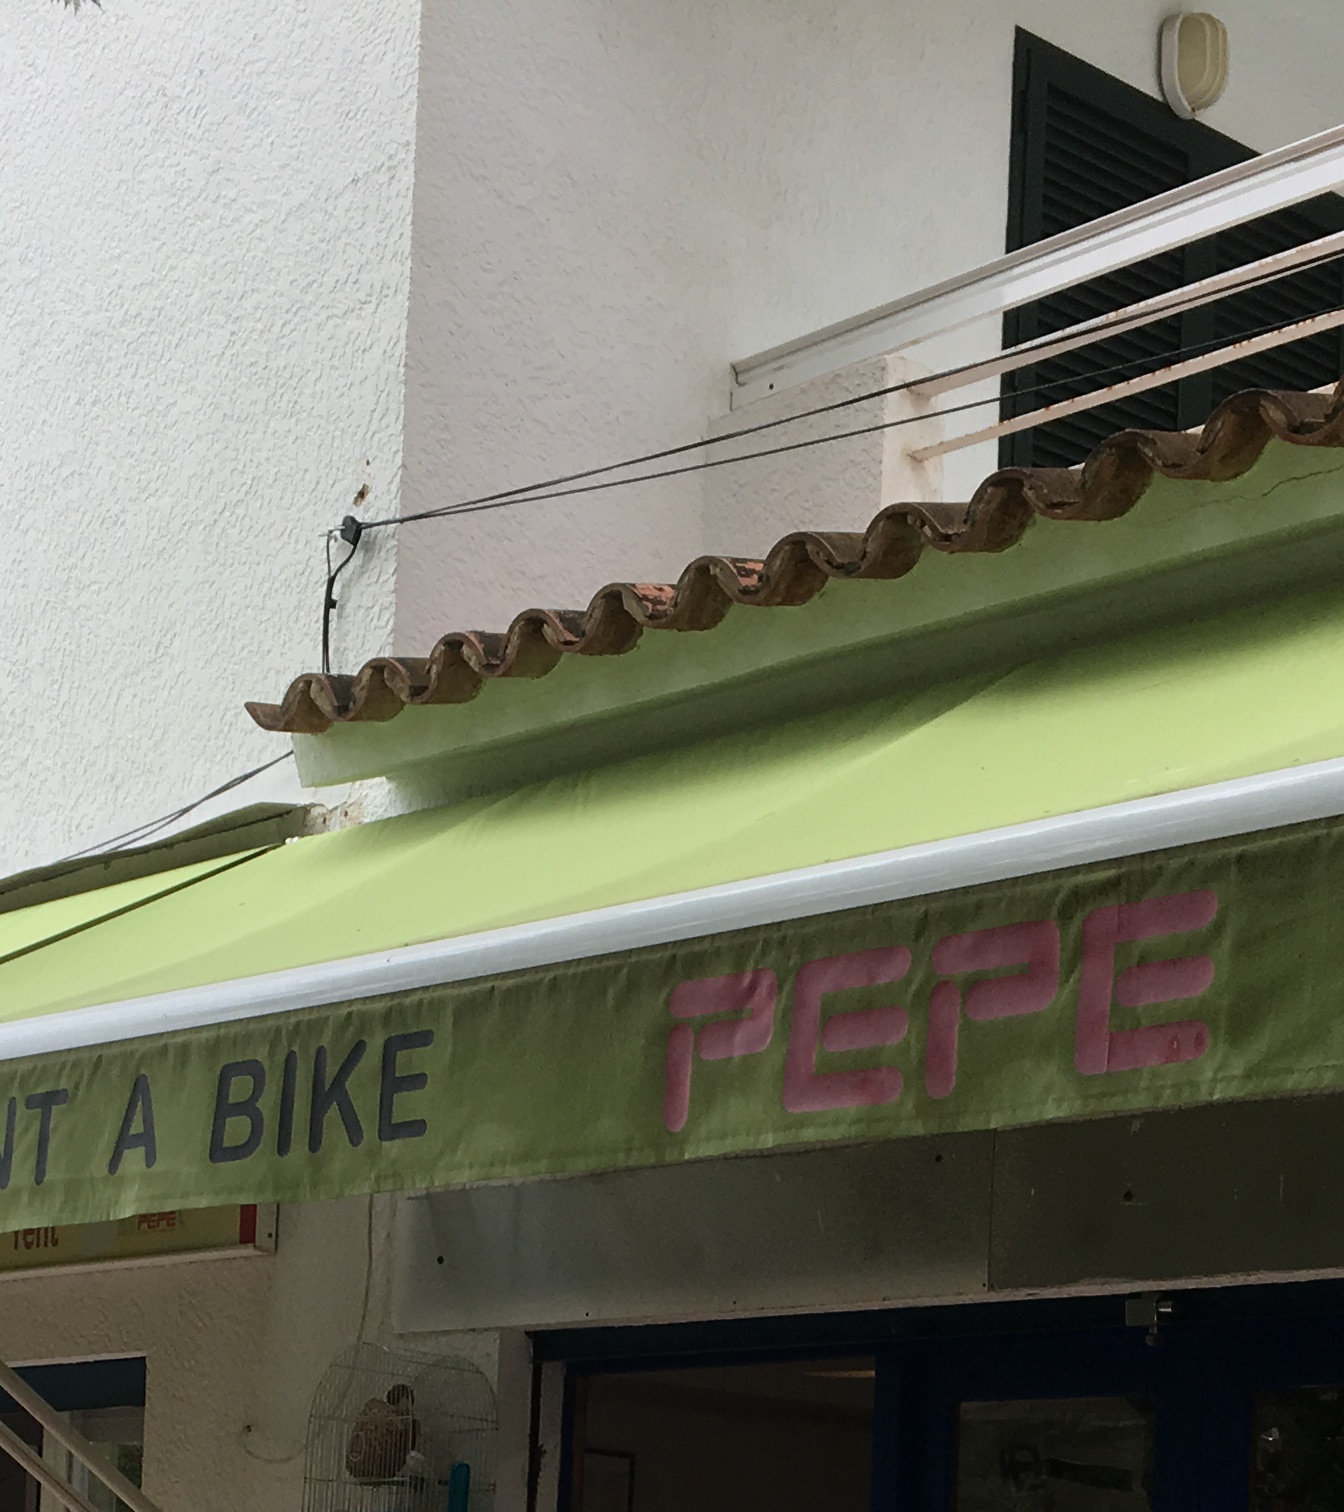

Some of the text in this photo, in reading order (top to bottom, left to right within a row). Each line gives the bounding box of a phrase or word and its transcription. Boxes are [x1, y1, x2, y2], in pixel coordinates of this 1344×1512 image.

[108, 1074, 158, 1176] A
[208, 1029, 435, 1164] BIKE
[663, 889, 1219, 1133] PEPE
[137, 1210, 177, 1231] PEPE
